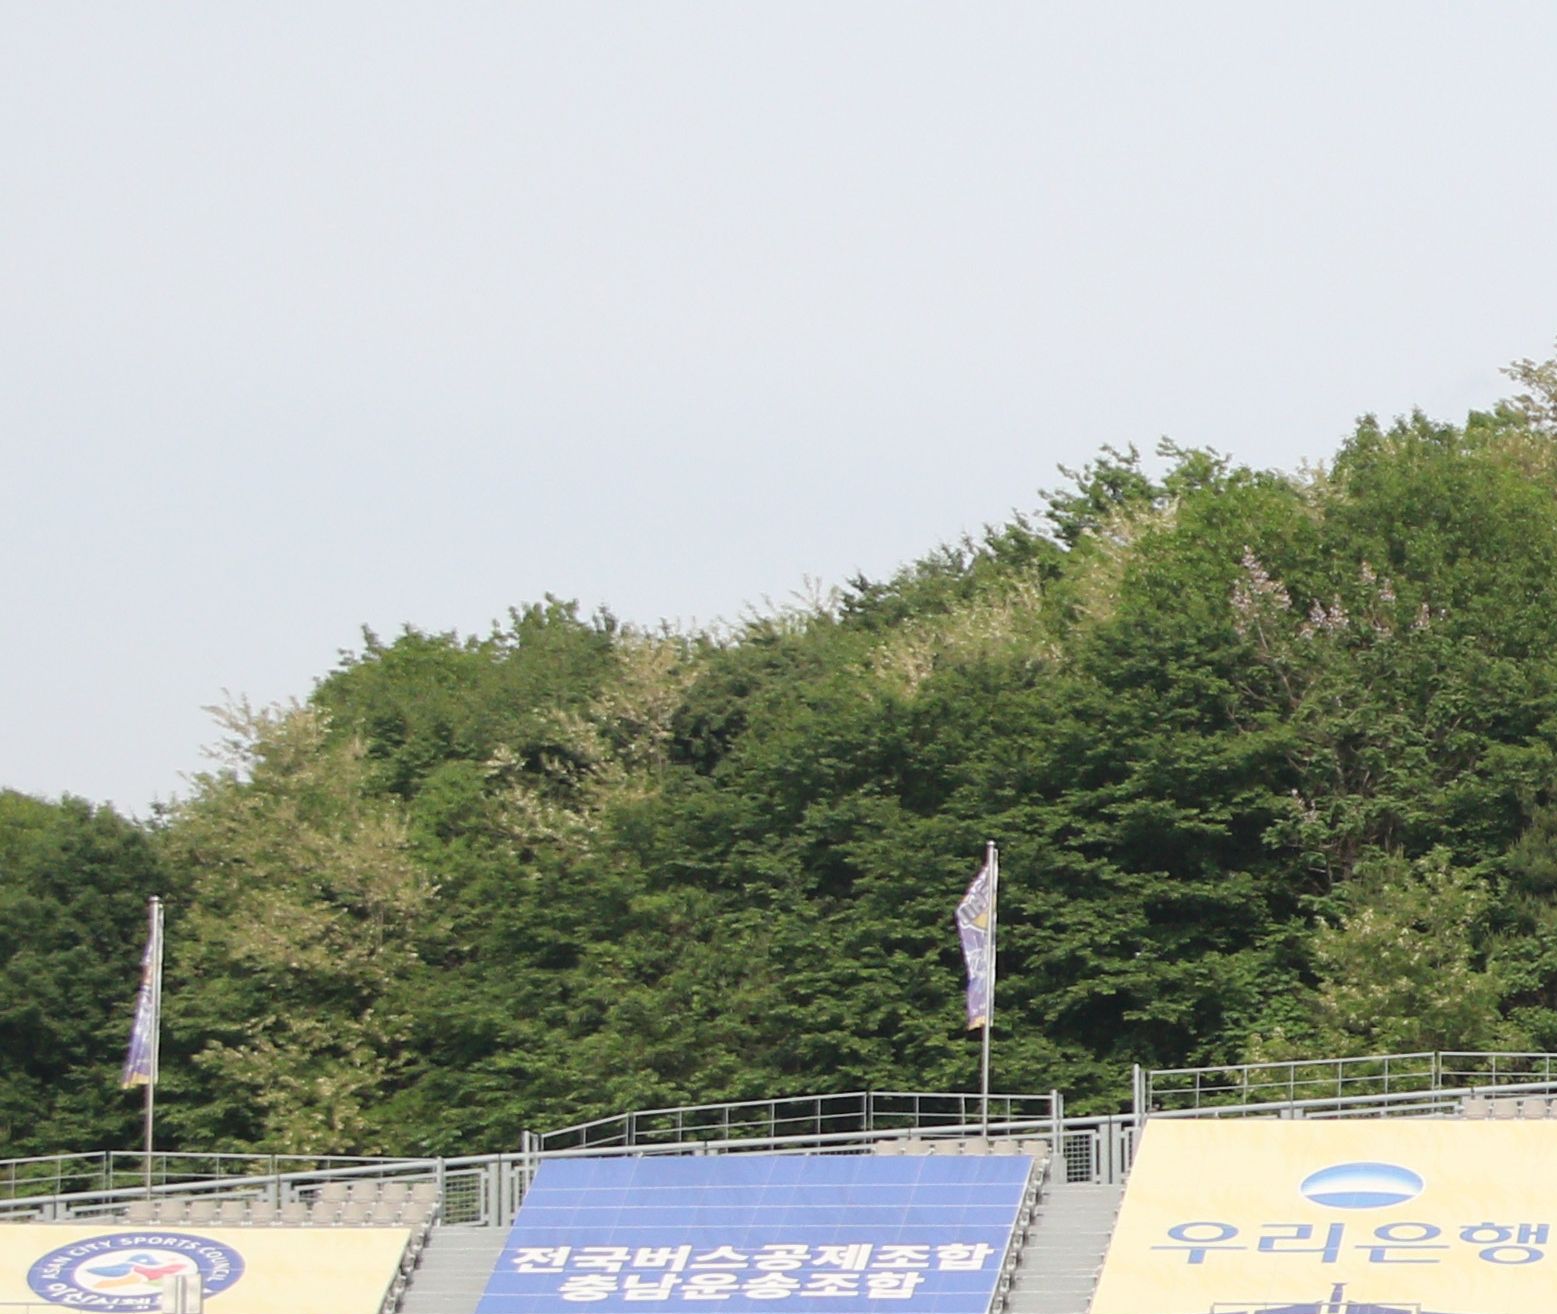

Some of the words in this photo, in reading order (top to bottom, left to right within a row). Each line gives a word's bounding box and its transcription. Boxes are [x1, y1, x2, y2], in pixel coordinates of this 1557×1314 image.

[70, 1240, 112, 1256] CITY
[120, 1236, 200, 1250] SPORTS
[198, 1246, 232, 1282] COUNCIL
[510, 1243, 994, 1274] 전국버스공제조합
[1150, 1221, 1549, 1266] 우리은행
[558, 1271, 926, 1301] 충남운송조합
